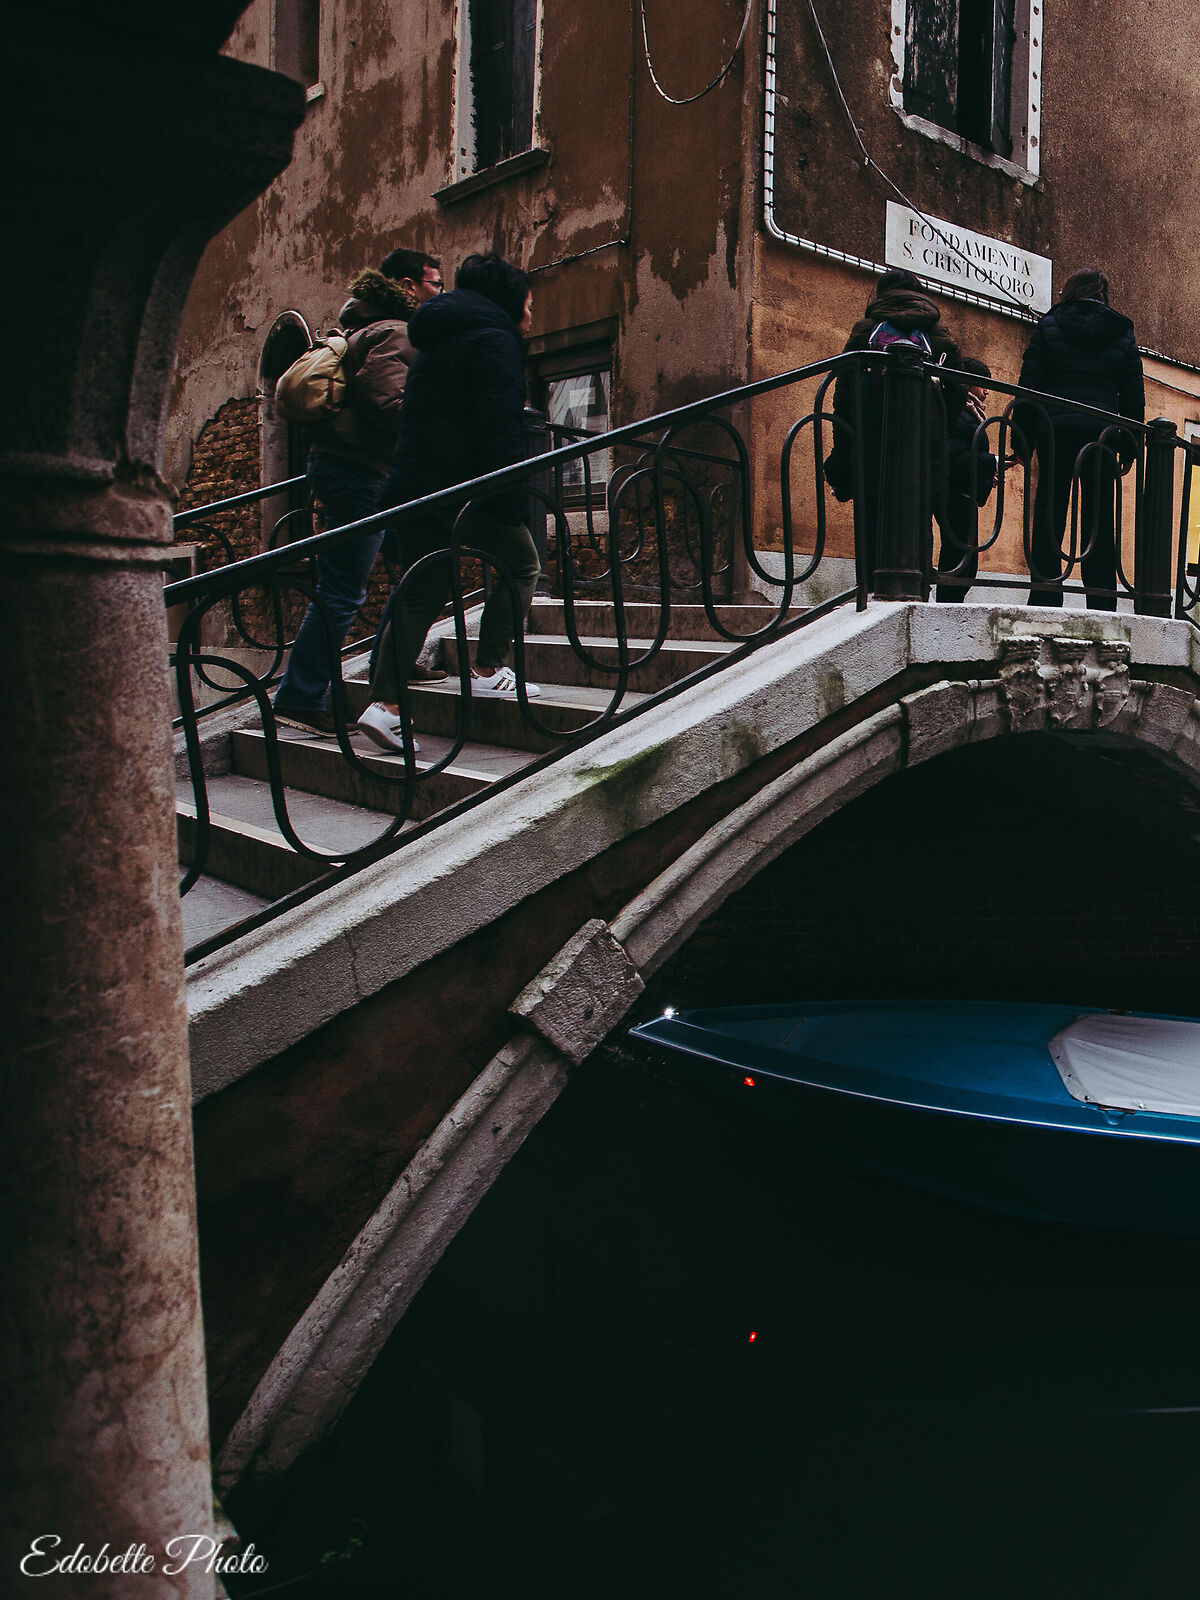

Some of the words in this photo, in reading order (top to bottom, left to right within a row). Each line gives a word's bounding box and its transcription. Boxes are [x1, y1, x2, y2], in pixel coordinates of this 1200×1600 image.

[902, 241, 915, 260] S.
[922, 248, 1035, 298] CRISTOFORO
[908, 218, 1031, 277] FONDAMENTA
